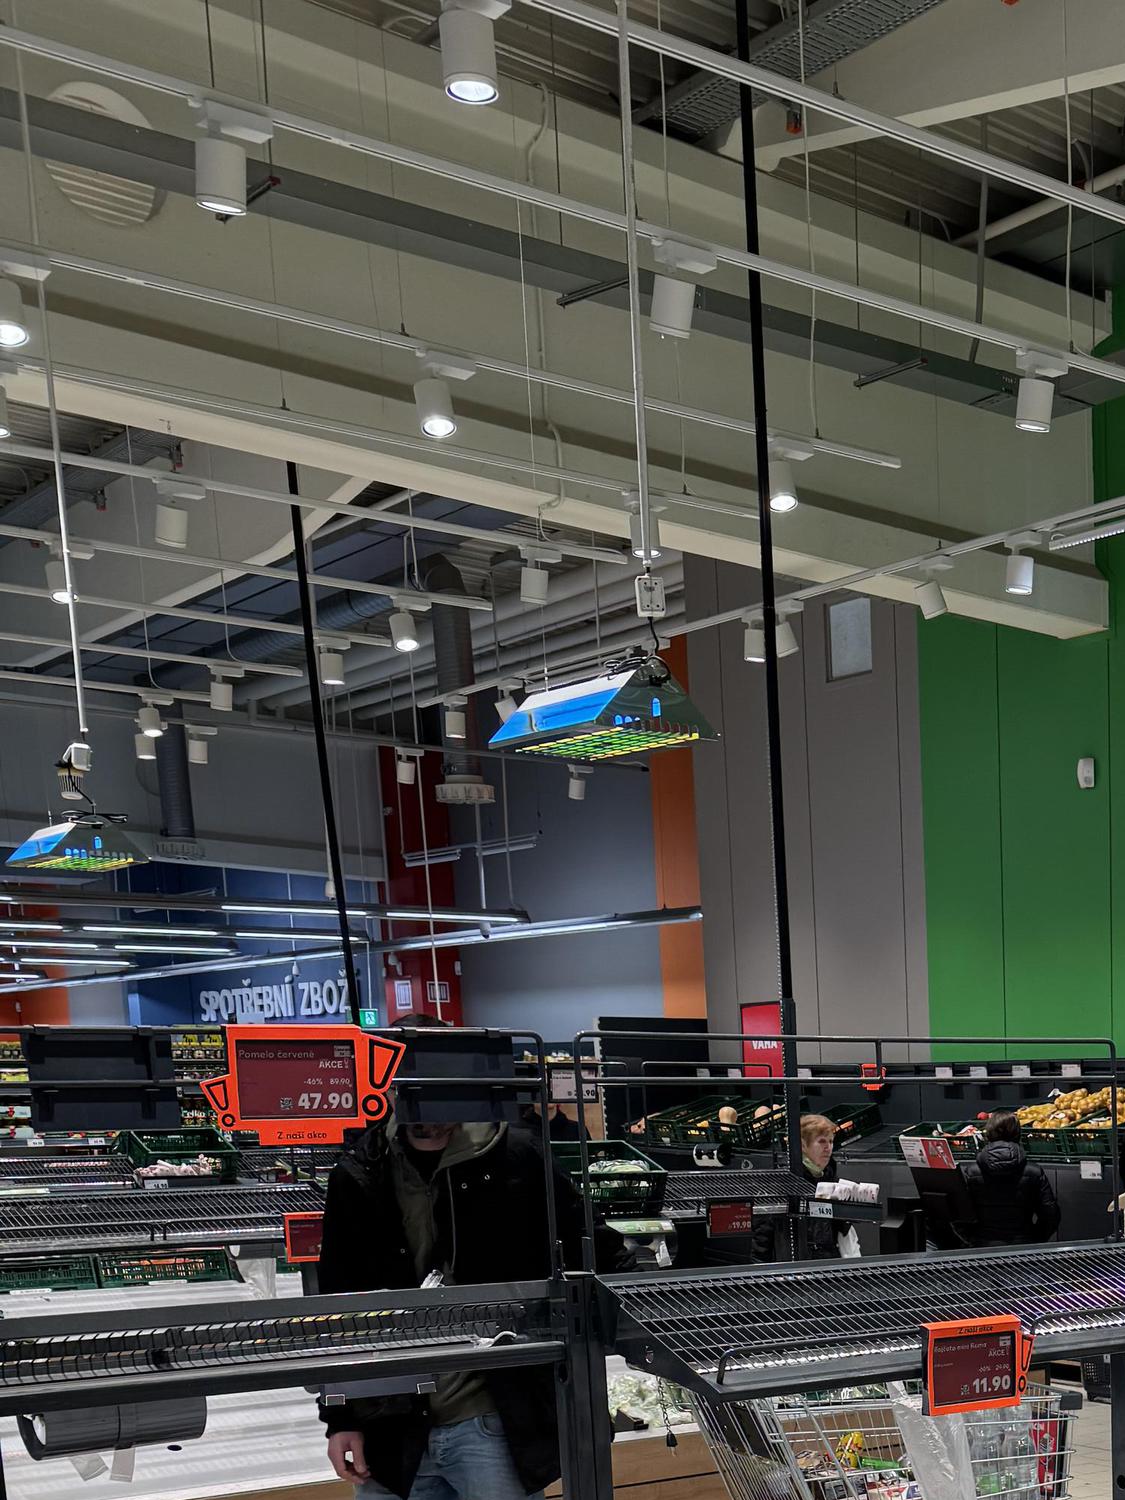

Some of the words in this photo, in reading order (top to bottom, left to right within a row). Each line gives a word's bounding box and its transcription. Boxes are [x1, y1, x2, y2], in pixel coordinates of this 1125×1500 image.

[200, 974, 295, 1022] SPOTŘEBNÍ
[299, 969, 352, 1016] ZBOŽ
[239, 1049, 275, 1059] Pomelo
[298, 1092, 354, 1110] 47.90
[972, 1374, 1011, 1394] 11.90
